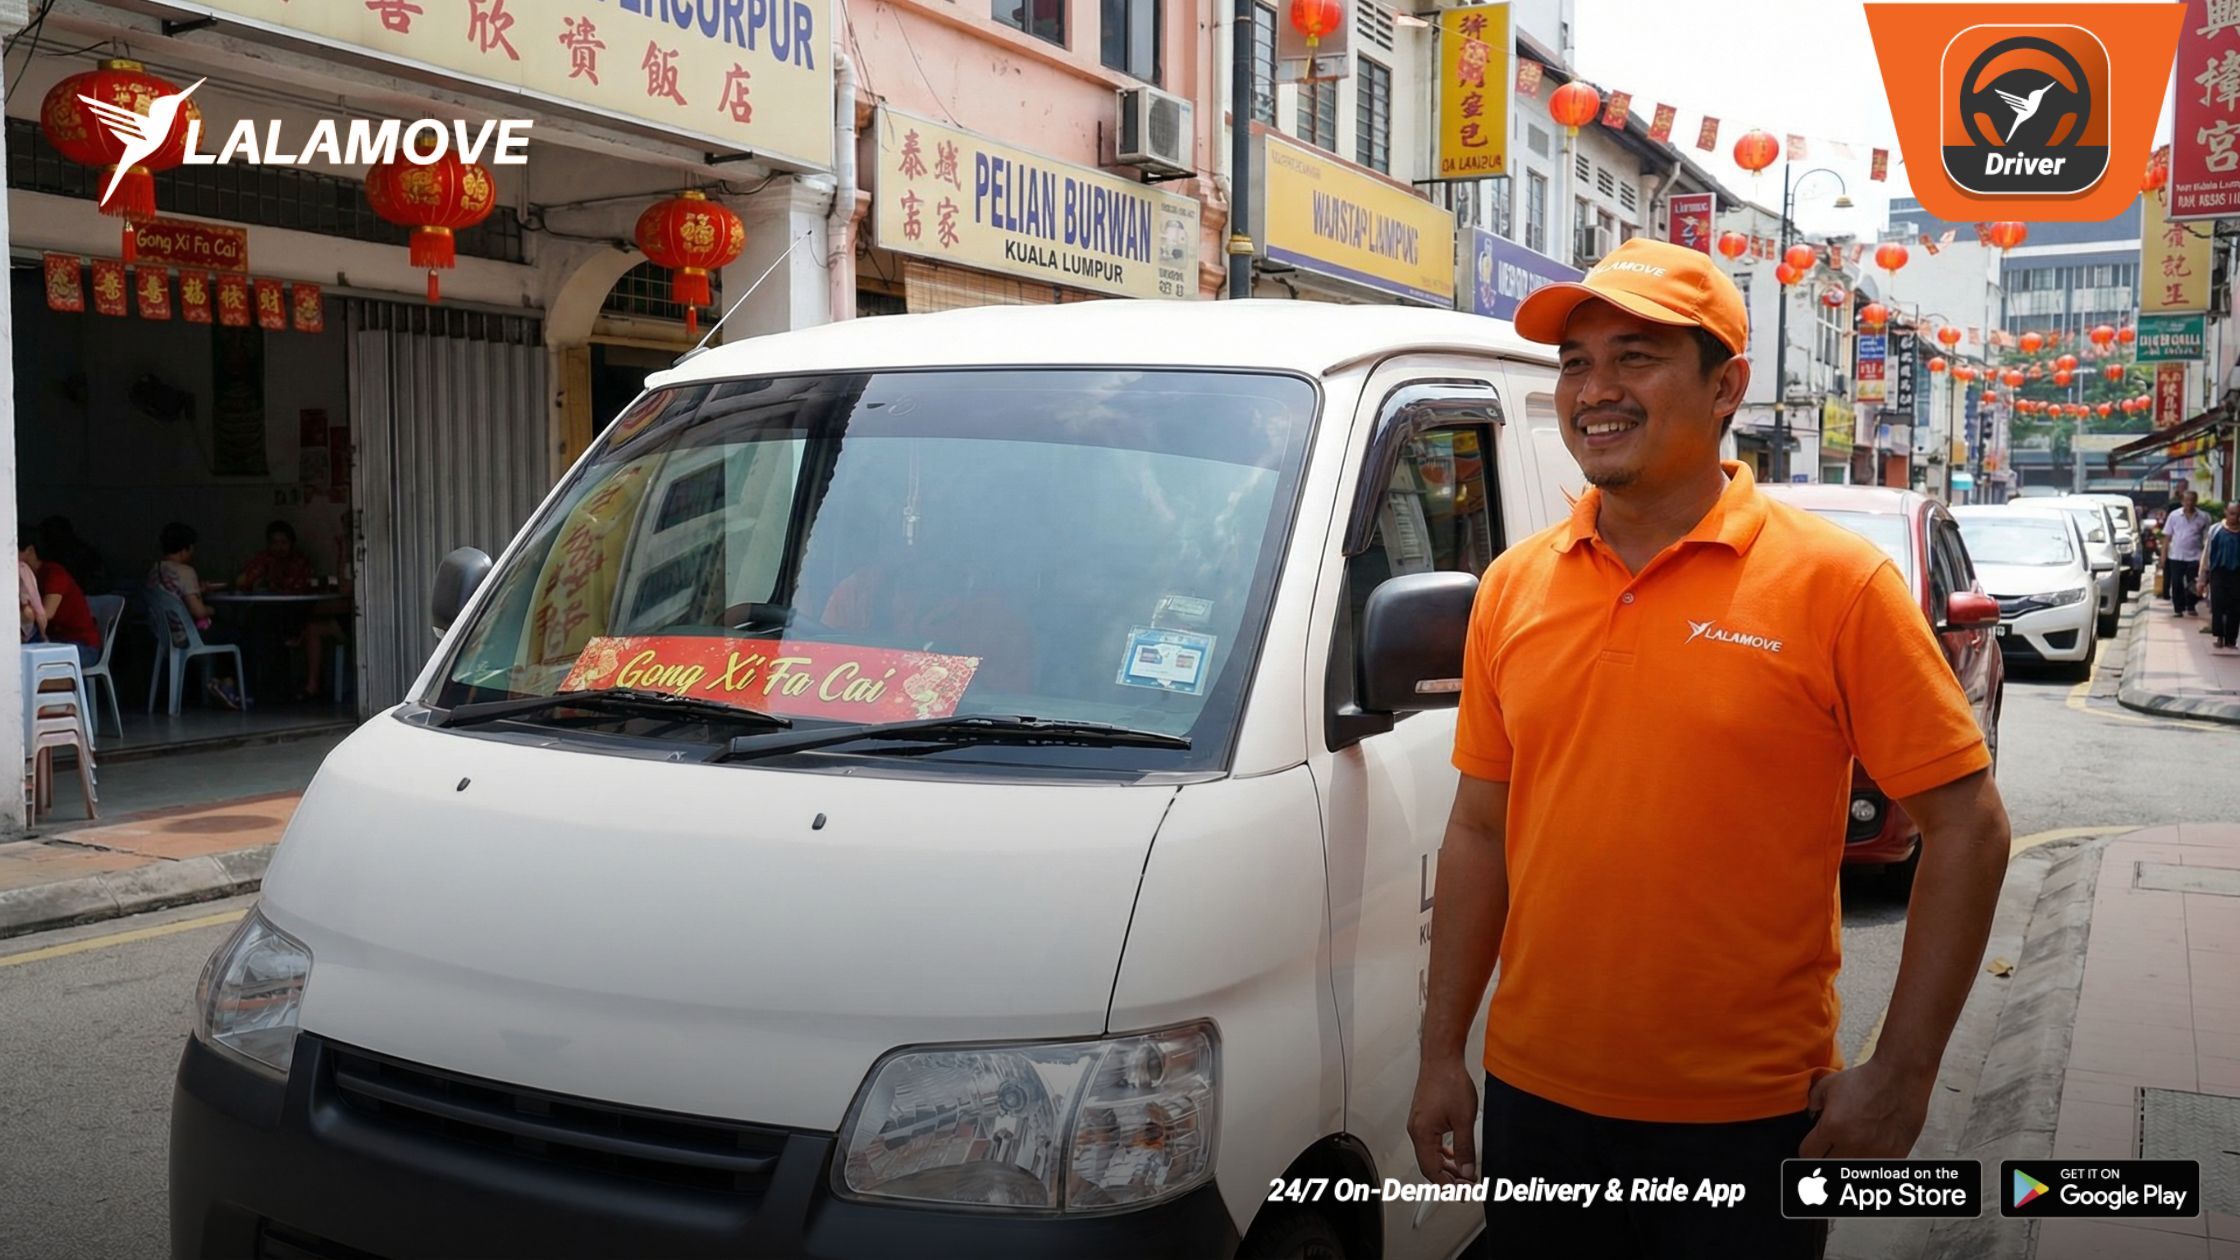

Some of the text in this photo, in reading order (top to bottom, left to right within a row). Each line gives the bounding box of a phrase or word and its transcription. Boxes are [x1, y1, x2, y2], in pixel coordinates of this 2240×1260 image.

[975, 151, 1152, 264] PELIAN BURWAN
[136, 228, 237, 257] Gong Xi Fa Cai
[1005, 239, 1058, 270] KUALA
[1062, 253, 1124, 285] LUMPUR
[1705, 627, 1783, 652] LALAMOVE
[615, 649, 898, 704] Gong Xi Fa Cai
